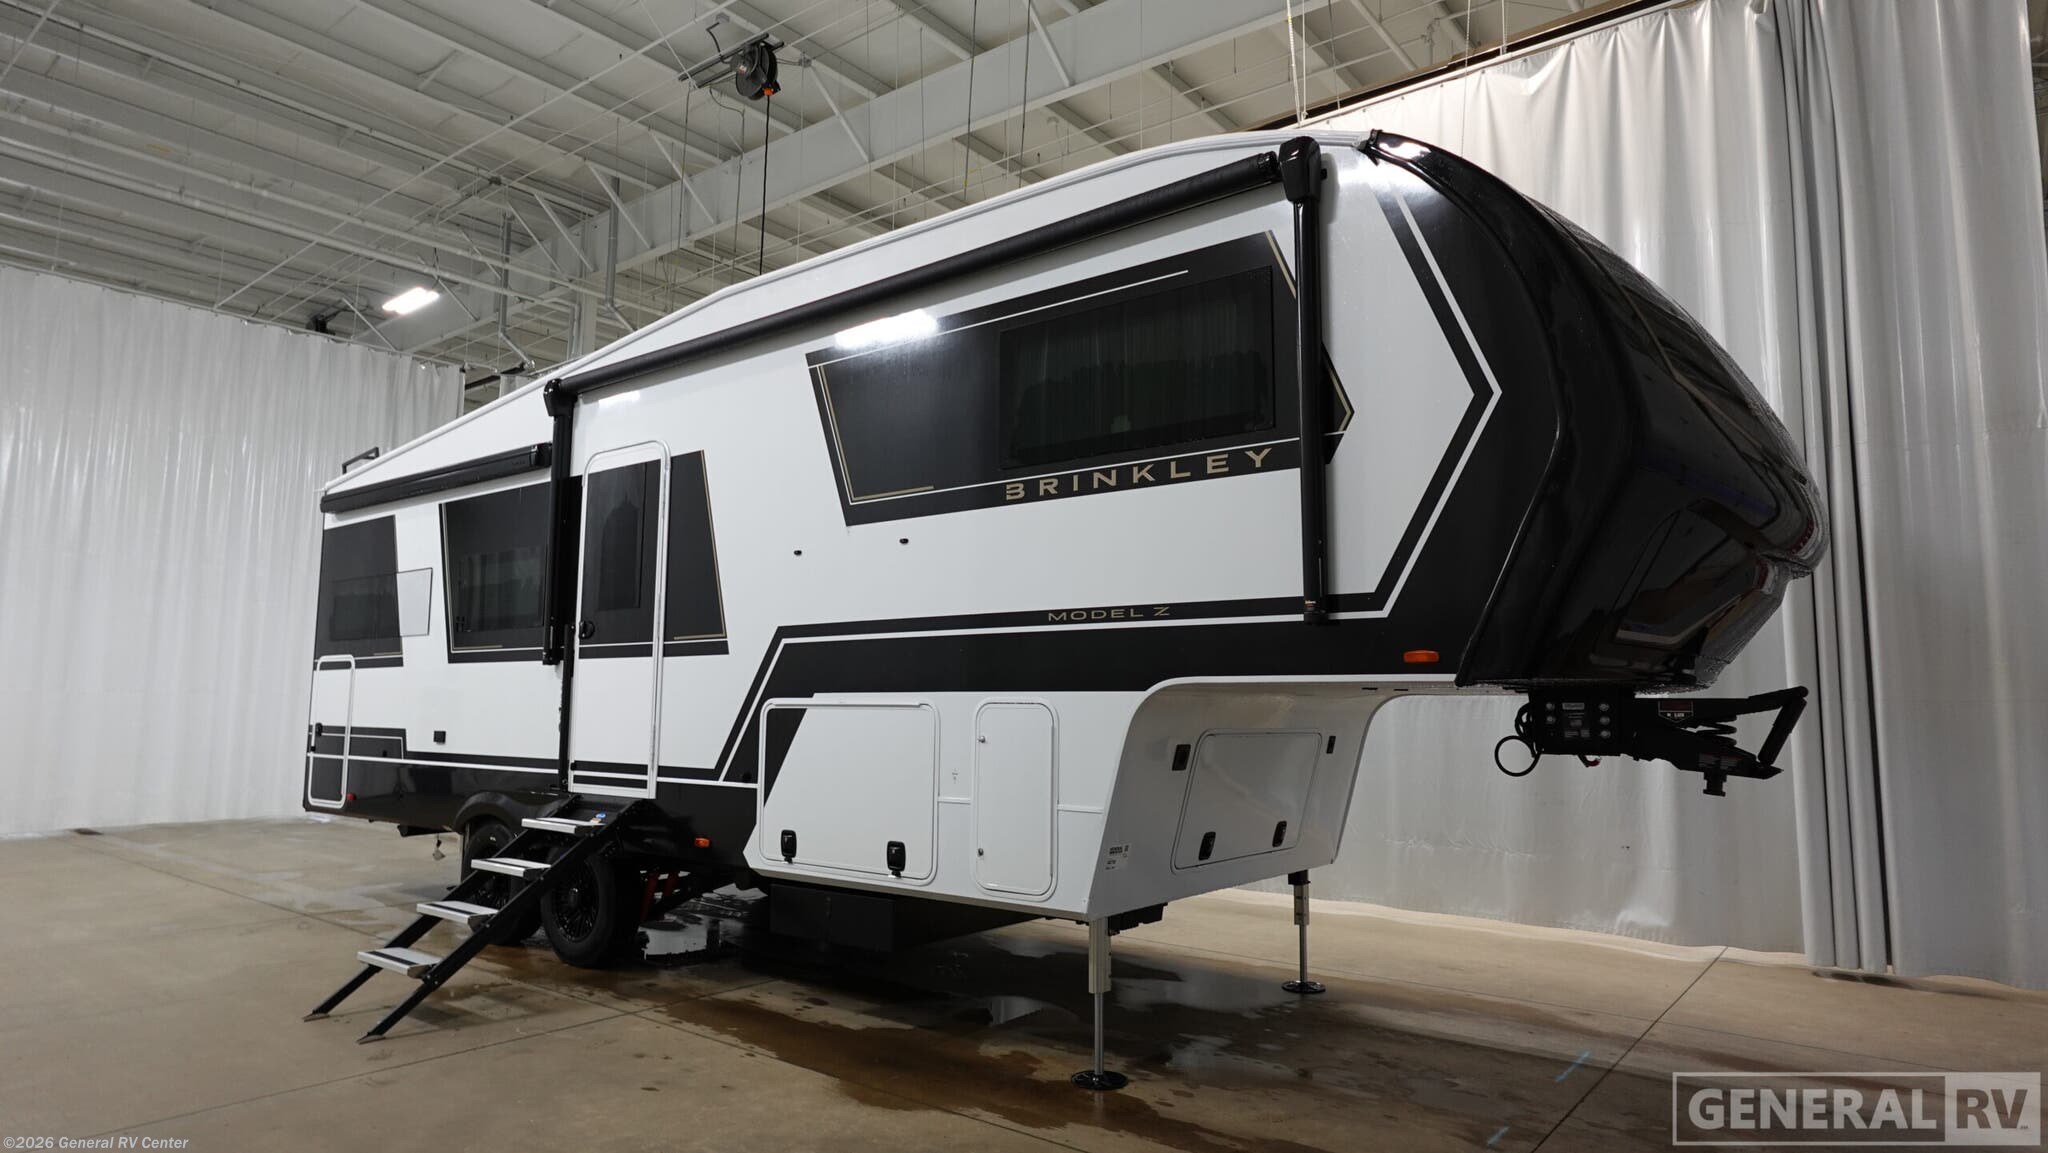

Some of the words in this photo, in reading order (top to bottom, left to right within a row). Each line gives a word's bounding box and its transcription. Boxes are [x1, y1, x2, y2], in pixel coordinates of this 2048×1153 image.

[1006, 448, 1273, 501] BRINKLEY
[1048, 608, 1144, 622] MODEL
[1153, 606, 1171, 616] Z
